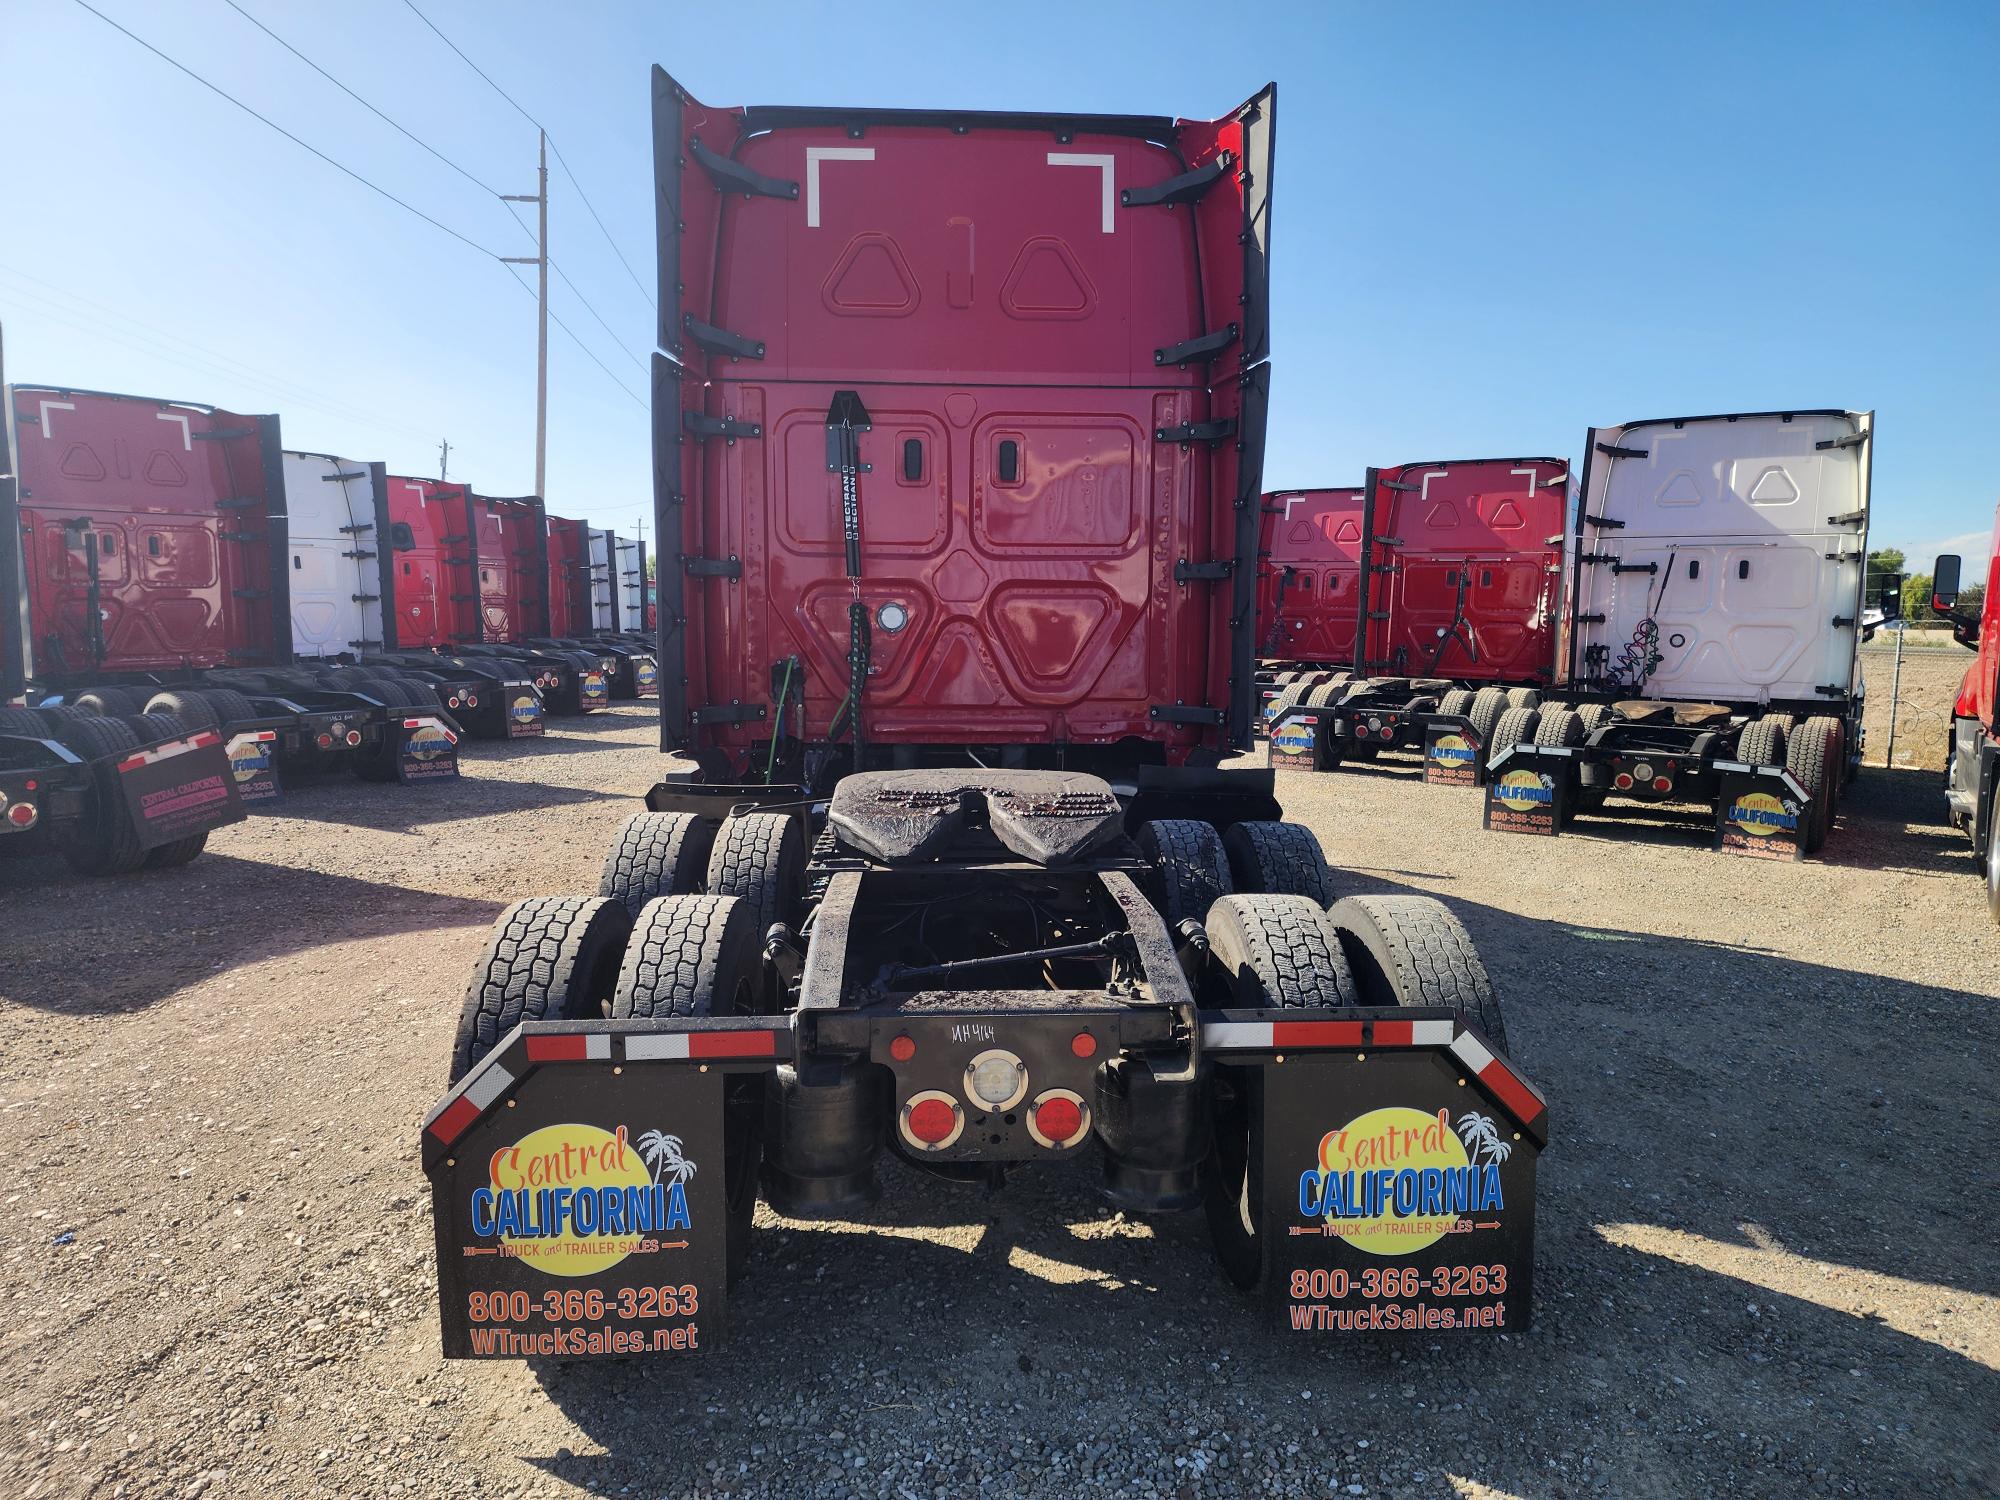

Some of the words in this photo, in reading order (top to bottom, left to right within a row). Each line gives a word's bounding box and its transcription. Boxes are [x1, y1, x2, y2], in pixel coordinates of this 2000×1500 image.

[843, 476, 852, 529] TECTRAN
[849, 477, 858, 530] TECTRAN
[1494, 784, 1553, 802] CALIFORNIA
[1501, 771, 1539, 787] Central
[1490, 811, 1553, 826] 800-366-3263
[1728, 805, 1798, 829] CALIFORNIA
[1736, 796, 1780, 811] Central
[1490, 821, 1552, 835] WTruckSales.net
[1722, 834, 1797, 854] 800-366-3263
[1318, 1107, 1450, 1174] Central
[490, 1125, 630, 1193] Central
[1299, 1163, 1505, 1219] CALIFORNIA
[471, 1183, 692, 1239] CALIFORNIA
[1321, 1223, 1362, 1237] TRUCK
[1365, 1221, 1384, 1236] and
[1384, 1221, 1432, 1236] TRAILER
[1435, 1219, 1474, 1234] SALES
[498, 1243, 540, 1257] TRUCK
[544, 1239, 563, 1257] and
[563, 1241, 616, 1256] TRAILER
[618, 1238, 660, 1254] SALES
[1289, 1264, 1508, 1299] 800-366-3263
[468, 1284, 700, 1322] 800-366-3263
[1289, 1301, 1507, 1331] WTruckSales.net
[470, 1322, 699, 1355] WTruckSales.net
